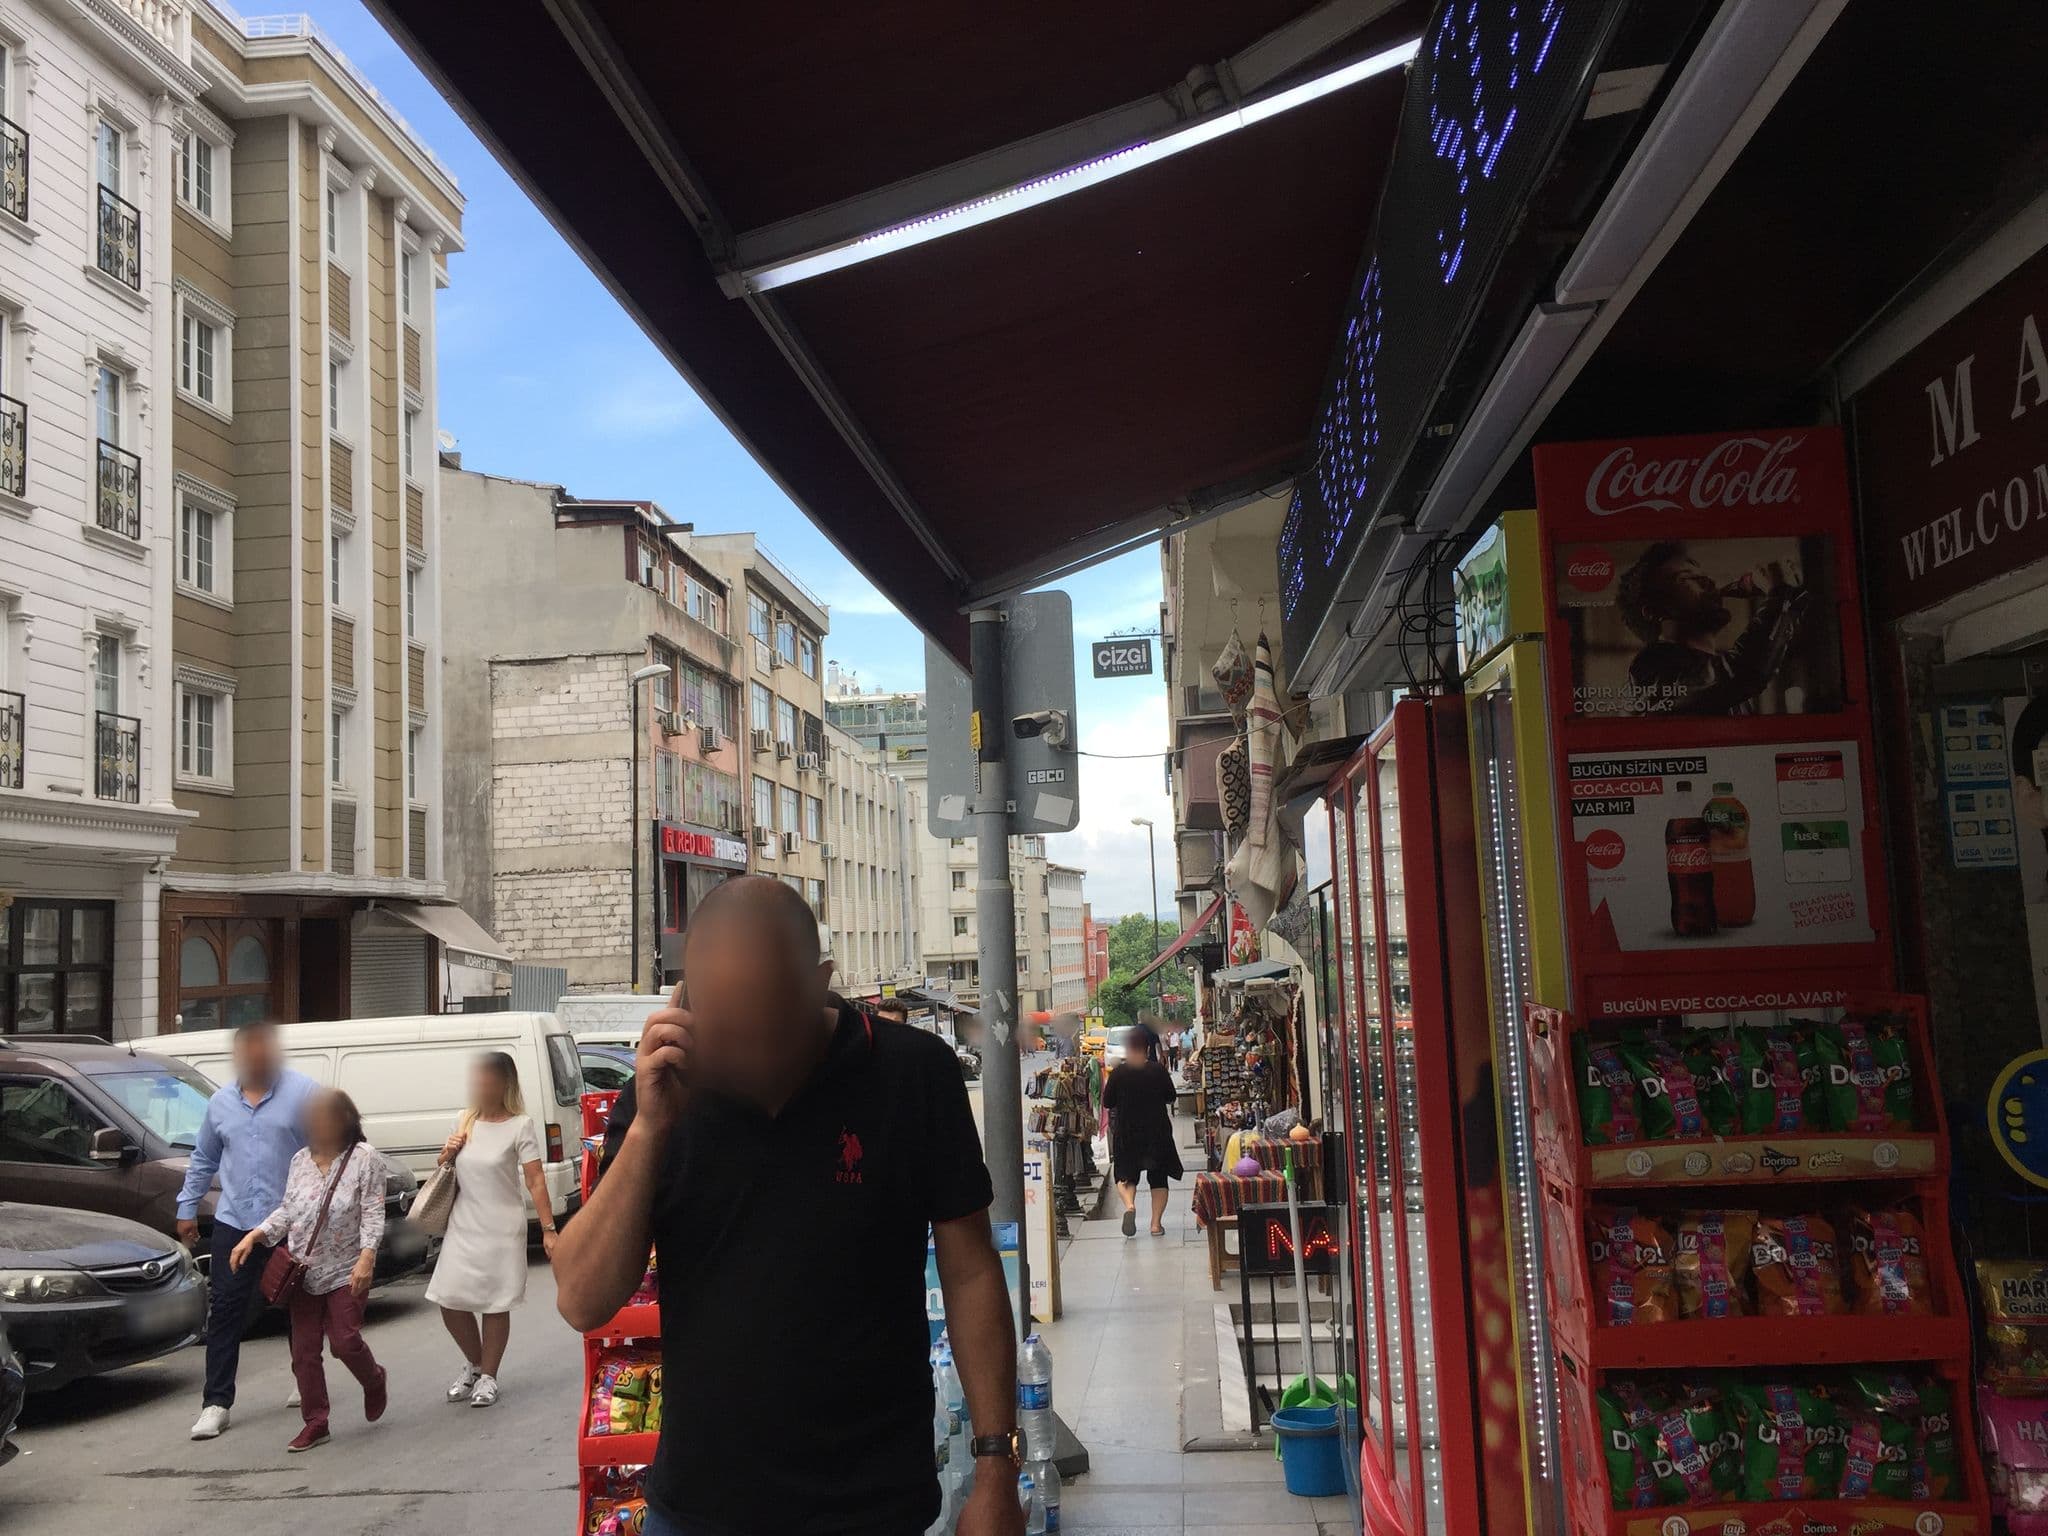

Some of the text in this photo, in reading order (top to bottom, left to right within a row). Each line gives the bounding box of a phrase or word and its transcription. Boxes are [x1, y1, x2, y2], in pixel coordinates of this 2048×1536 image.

[1585, 434, 1807, 516] Coca-Cola
[1568, 560, 1611, 577] Coca-Cola
[1097, 643, 1147, 670] ÇİZGİ
[1572, 687, 1613, 699] KIPIR
[1662, 684, 1688, 697] BİR
[1572, 760, 1705, 777] BUGÜN SİZİN EVDE
[1573, 781, 1660, 796] COCA-COLA
[1575, 800, 1632, 815] VAR MI?
[677, 828, 696, 854] RED
[714, 836, 747, 864] FITNESS
[1585, 843, 1624, 857] Coca-Cola
[1602, 998, 1657, 1015] BUGÜN
[1660, 997, 1702, 1012] EVDE
[1704, 992, 1796, 1010] COCA-COLA
[1800, 991, 1833, 1005] VAR
[1763, 1156, 1797, 1167] Doritos
[1803, 1523, 1839, 1534] Doritos
